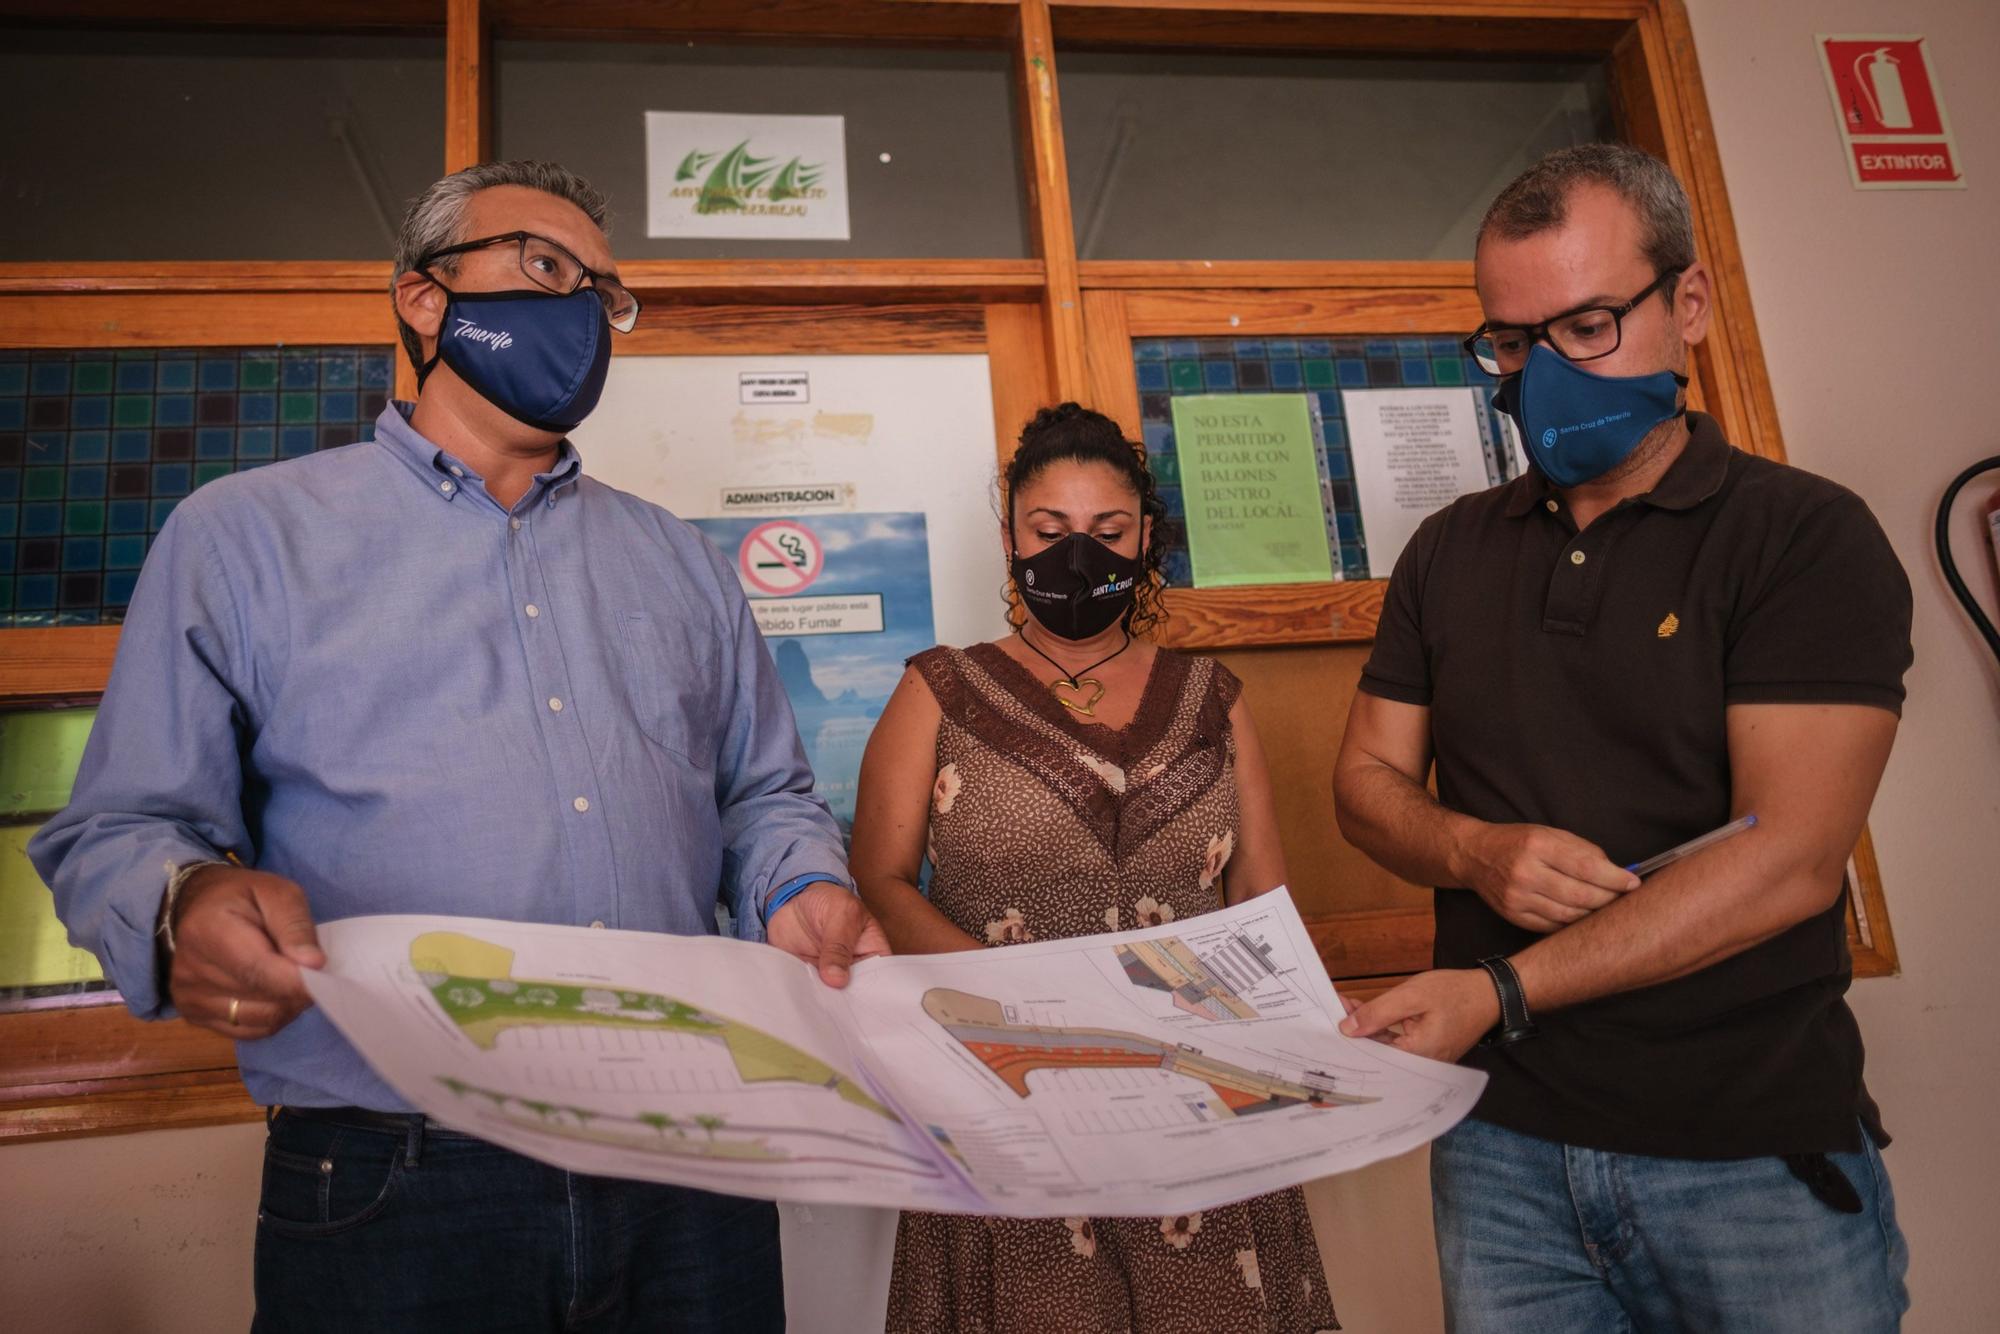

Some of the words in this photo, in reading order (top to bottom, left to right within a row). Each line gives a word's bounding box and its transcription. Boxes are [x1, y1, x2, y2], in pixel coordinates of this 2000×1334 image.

[1860, 154, 1946, 170] EXTINTOR
[453, 318, 513, 351] Tenerife
[1193, 415, 1218, 428] NO
[1222, 415, 1263, 428] ESTA
[1560, 425, 1580, 434] Santa
[1580, 421, 1596, 430] Cruz
[1596, 418, 1605, 426] de
[1605, 411, 1631, 422] Tenerife
[1196, 432, 1286, 447] PERMITIDO
[1199, 450, 1252, 465] JUGAR
[1255, 449, 1290, 463] CON
[1201, 469, 1278, 483] BALONES
[725, 489, 835, 504] ADMINISTRACION
[1203, 487, 1271, 502] DENTRO
[1206, 505, 1240, 520] DEL
[792, 603, 813, 614] lugar
[798, 617, 842, 629] Fumar
